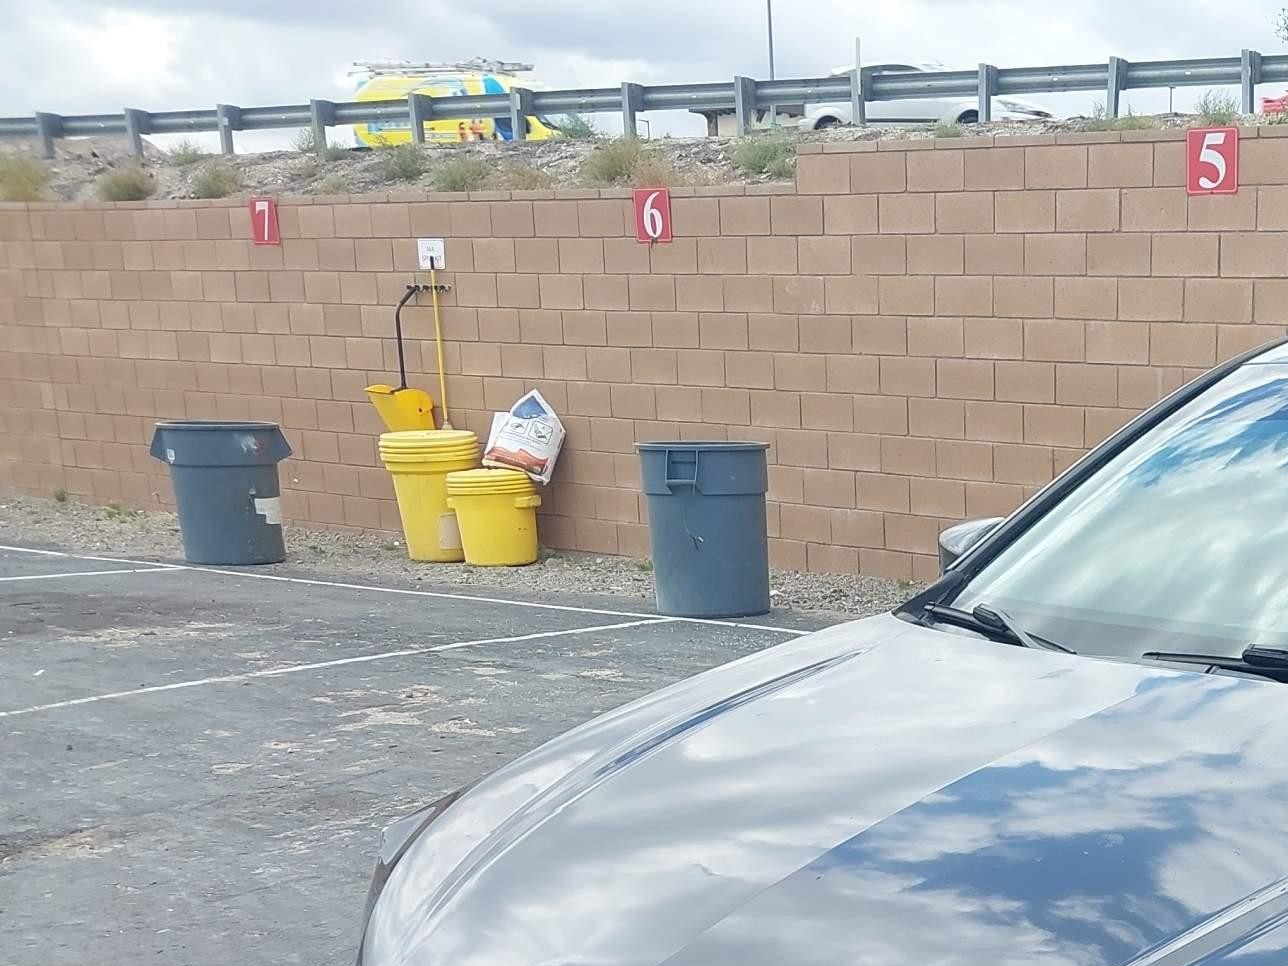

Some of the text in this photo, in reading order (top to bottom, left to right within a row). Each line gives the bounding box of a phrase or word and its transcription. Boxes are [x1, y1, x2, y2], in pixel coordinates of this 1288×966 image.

[1198, 132, 1226, 189] 5
[255, 201, 269, 241] 7
[643, 191, 663, 238] 6
